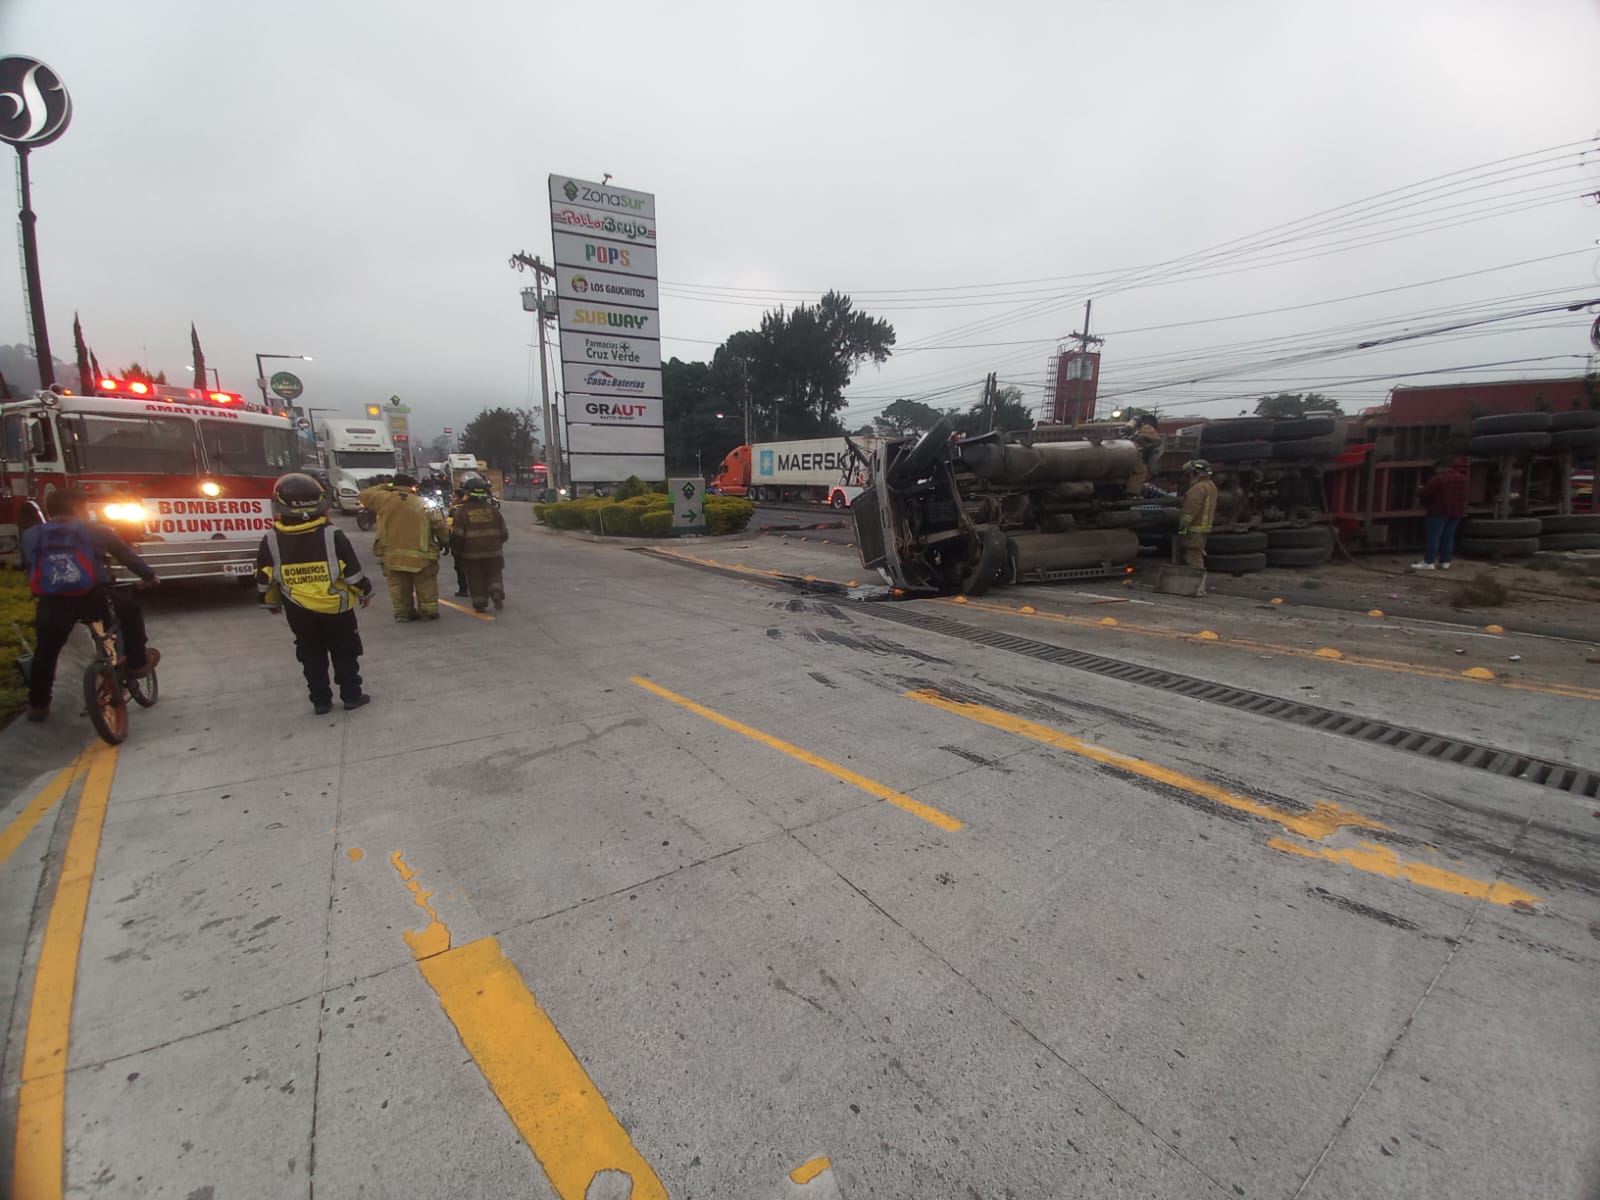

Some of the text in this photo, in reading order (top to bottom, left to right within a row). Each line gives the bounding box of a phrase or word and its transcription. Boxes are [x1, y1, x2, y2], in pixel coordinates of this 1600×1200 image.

[585, 243, 630, 267] POPS
[590, 282, 645, 298] LOS GAUCHITOS
[574, 309, 648, 329] SUBWAY
[585, 339, 618, 350] Farmacias
[586, 347, 641, 363] Cruz Verde
[585, 402, 647, 417] GRAUT
[777, 452, 850, 471] MAERSK
[159, 500, 263, 515] BOMBEROS
[147, 518, 274, 533] VOLUNTARIOS
[284, 565, 326, 577] BOMBEROS
[284, 574, 329, 586] VOLUNTARIOS
